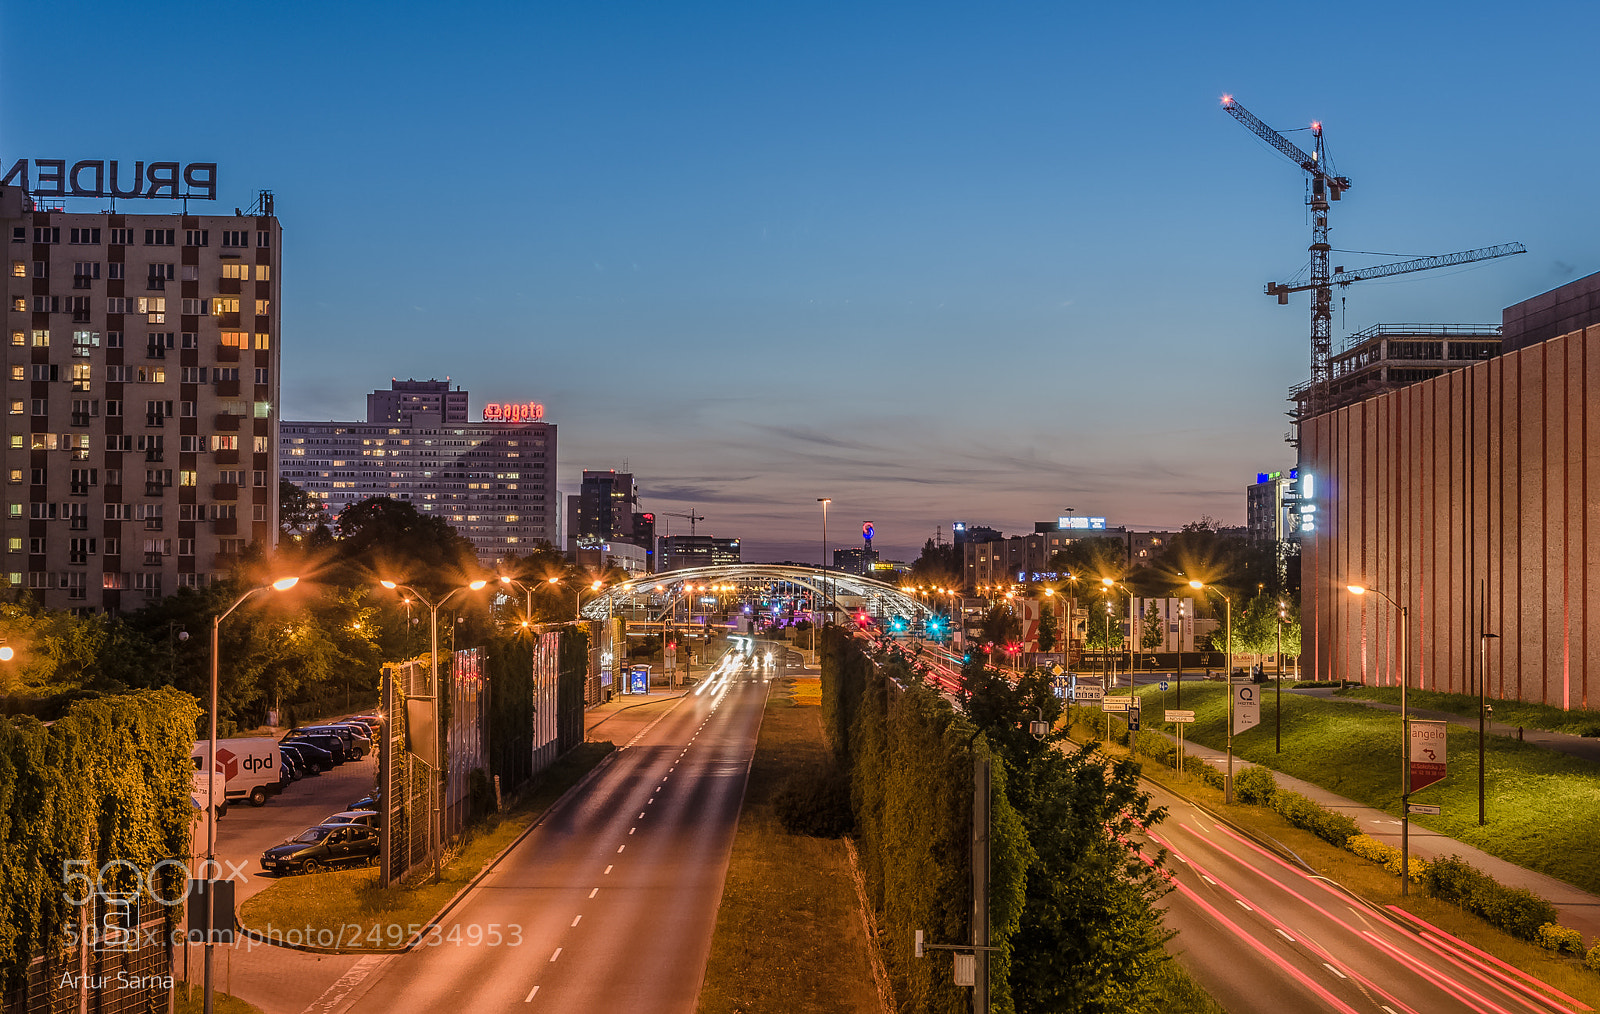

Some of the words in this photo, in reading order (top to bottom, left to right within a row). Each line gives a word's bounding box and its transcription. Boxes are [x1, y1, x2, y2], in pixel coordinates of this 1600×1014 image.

[503, 401, 544, 422] agata
[1411, 729, 1445, 741] angelo
[242, 752, 273, 774] dpd
